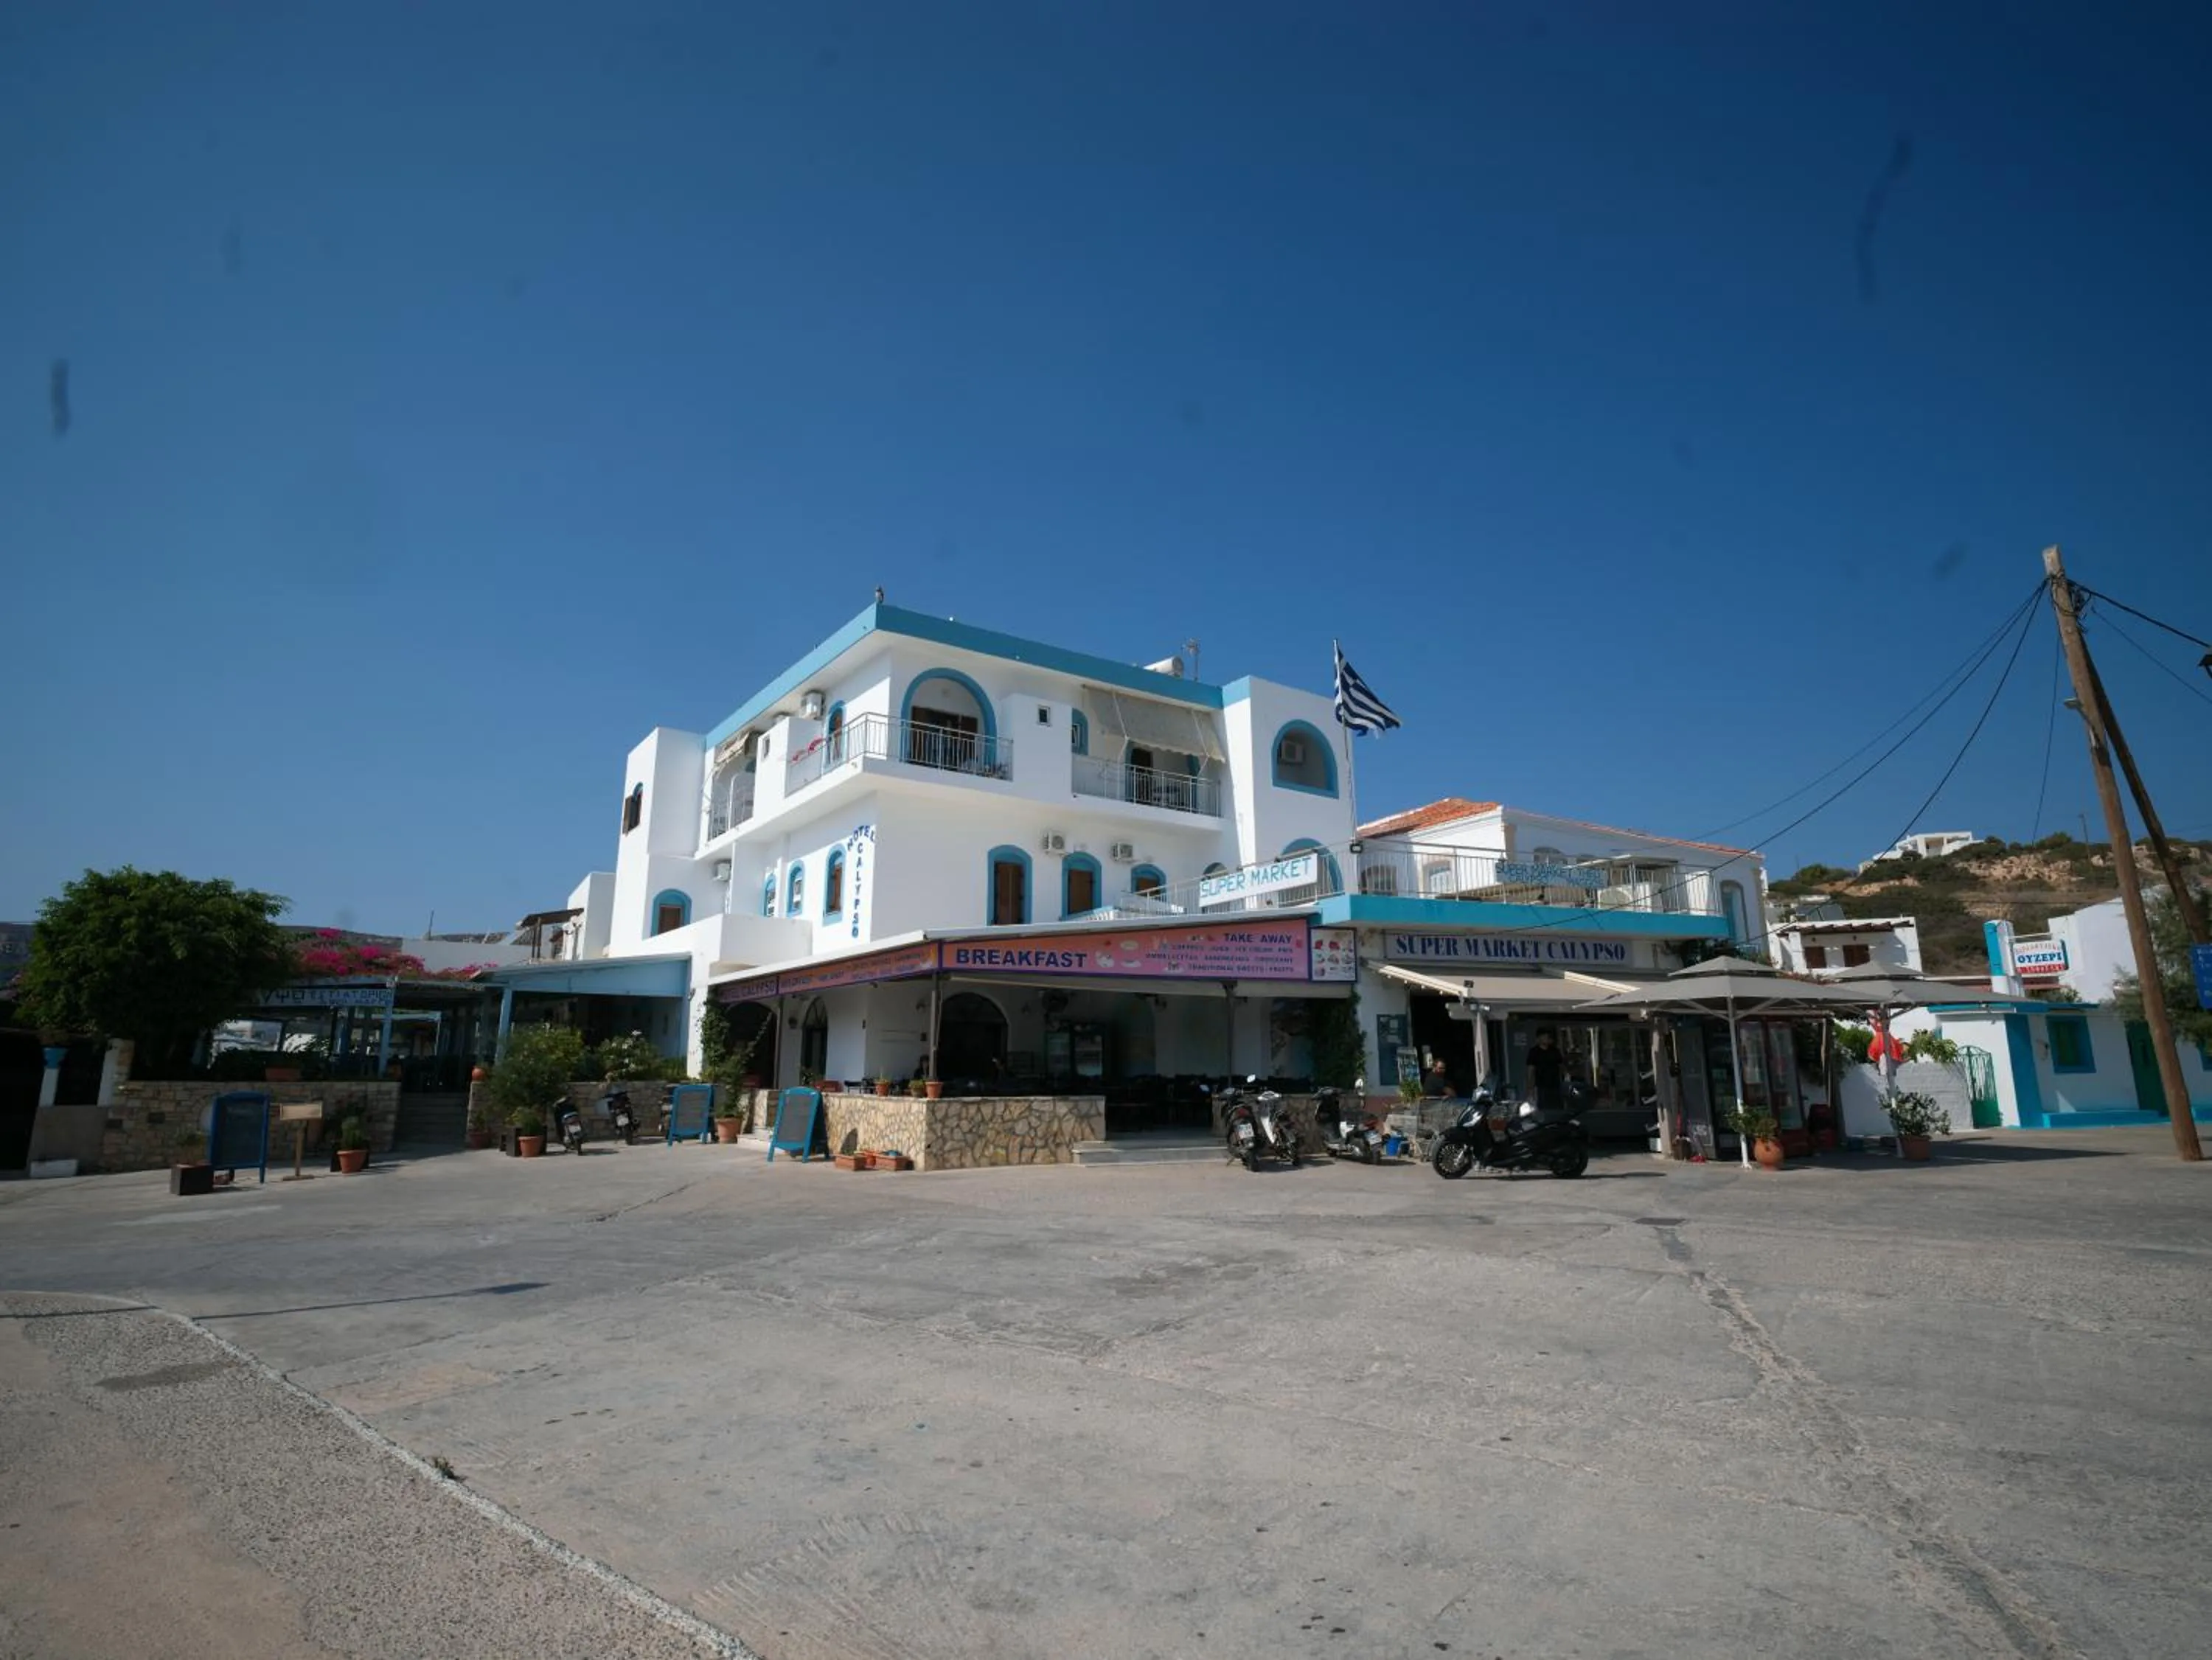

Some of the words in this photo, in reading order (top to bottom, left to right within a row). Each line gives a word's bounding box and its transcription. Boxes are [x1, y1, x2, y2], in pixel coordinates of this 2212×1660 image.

[847, 825, 875, 851] HOTEL
[852, 843, 863, 938] CALYPSO
[1200, 871, 1245, 898] SUPER
[1250, 857, 1312, 885] MARKET
[1223, 932, 1253, 943] TAKE
[1260, 933, 1293, 944] AWAY
[1396, 934, 1460, 956] SUPER
[1464, 937, 1540, 958] MARKET
[1548, 939, 1627, 960] CALYPSO
[956, 948, 1088, 968] BREAKFAST
